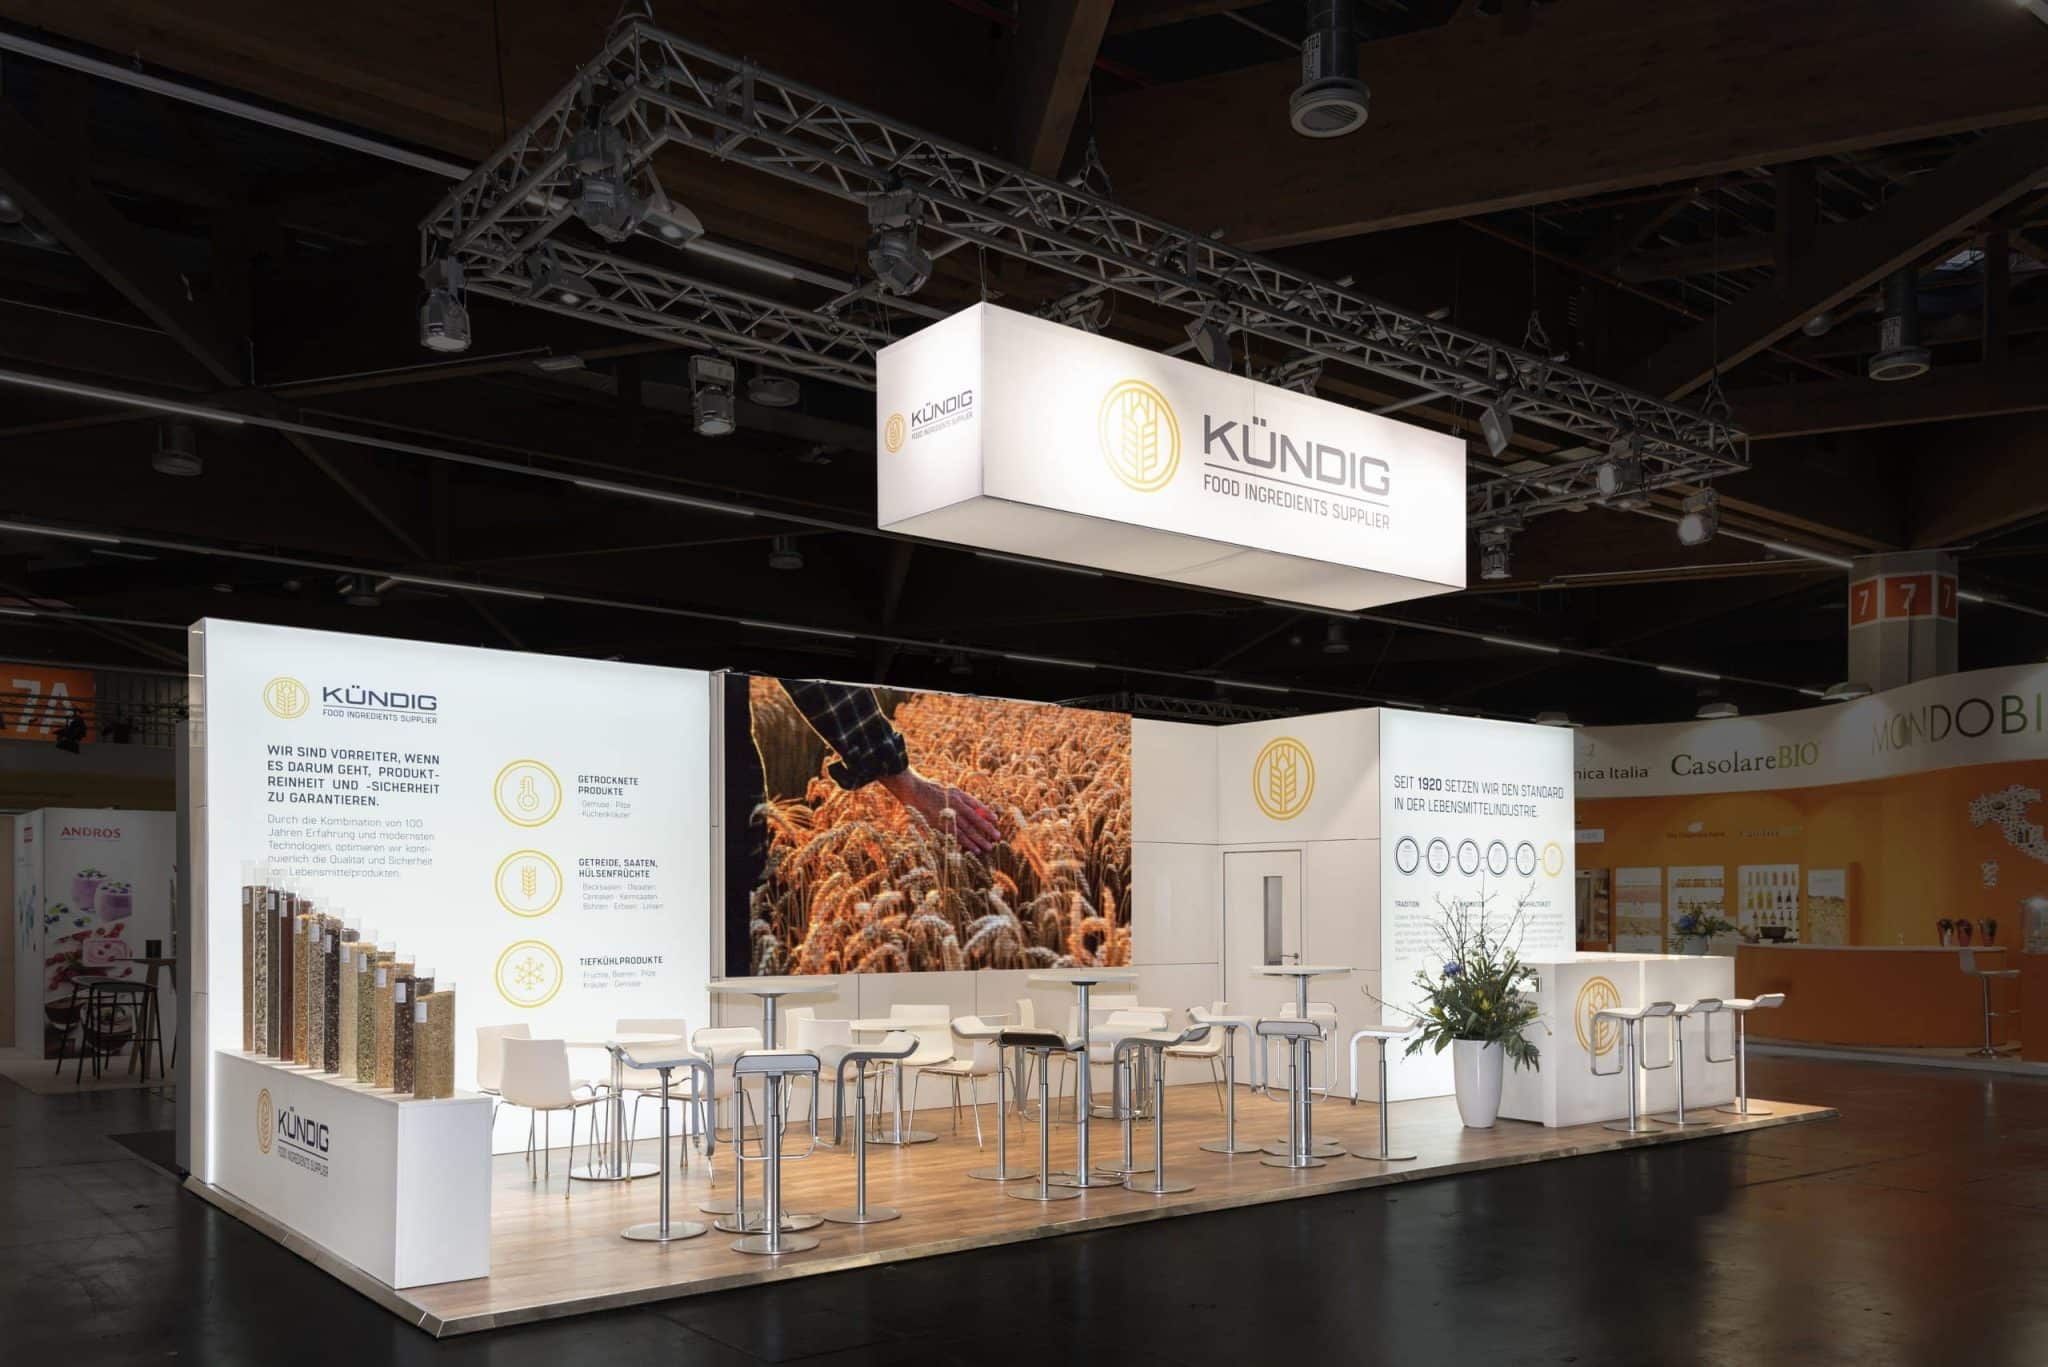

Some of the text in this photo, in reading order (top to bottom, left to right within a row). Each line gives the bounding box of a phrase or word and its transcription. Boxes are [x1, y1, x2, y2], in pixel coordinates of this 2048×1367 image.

[911, 390, 972, 427] KÜNDIG
[1204, 414, 1390, 496] KÜNDIG
[1204, 474, 1390, 530] FOOD INGREDIENTS SUPPLIER
[1859, 590, 1869, 616] 7
[1900, 583, 1917, 609] 7
[1944, 584, 1951, 608] 7
[323, 685, 437, 711] KÜNDIG
[12, 679, 76, 734] 7A
[323, 709, 437, 724] FOOD INGREDIENTS SUPPLIER
[267, 744, 440, 765] WIR SIND VORREITER, WENN
[1671, 742, 1819, 777] CasolareBIO
[268, 760, 440, 780] ES DARUM GEHT, PRODUKT-
[1610, 766, 1648, 780] Italia
[268, 776, 440, 794] REINHEIT UND -SICHERHEIT
[578, 774, 639, 786] GETROCKNETE
[1394, 775, 1564, 800] SEIT 1920 SETZEN WIR DEN STANDARD
[578, 786, 624, 796] PRODUKTE
[268, 792, 380, 807] ZU GARANTIEREN.
[1394, 797, 1404, 811] IN
[1407, 797, 1425, 812] DER
[267, 814, 423, 829] Durch die Kombination von 100
[60, 826, 121, 839] ANDROS
[268, 828, 435, 841] Jahren Erfahrung und modernsten
[335, 841, 385, 853] optimieren
[312, 854, 327, 865] die
[368, 855, 385, 865] und
[389, 855, 432, 866] Sicherheit
[578, 858, 658, 868] GETREIDE, SAATEN,
[579, 867, 650, 878] HÜLSENFRÜCHTE
[580, 955, 663, 966] TIEFKÜHLPRODUKTE
[278, 1106, 328, 1152] KÜNDIG
